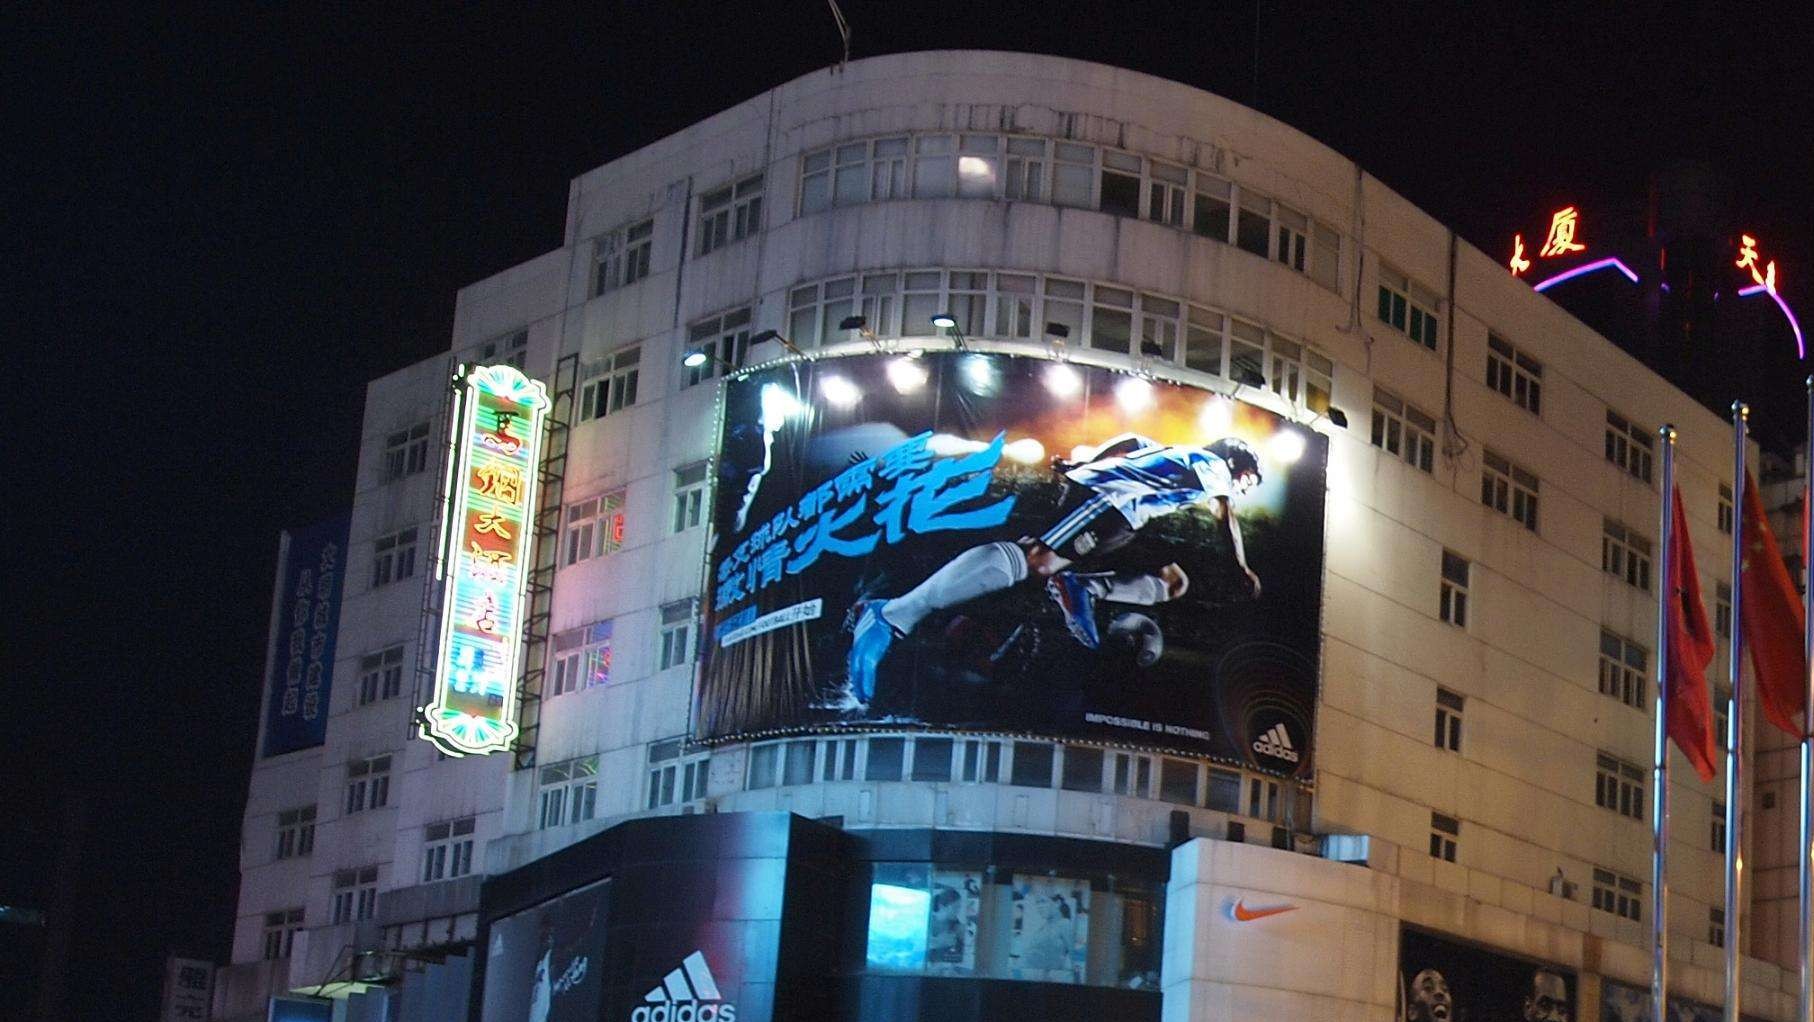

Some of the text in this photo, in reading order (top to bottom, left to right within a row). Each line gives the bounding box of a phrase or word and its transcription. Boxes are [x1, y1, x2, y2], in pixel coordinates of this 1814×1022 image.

[1085, 711, 1211, 740] IMPOSSIBLE IS NOTHING
[1252, 741, 1299, 763] adidas
